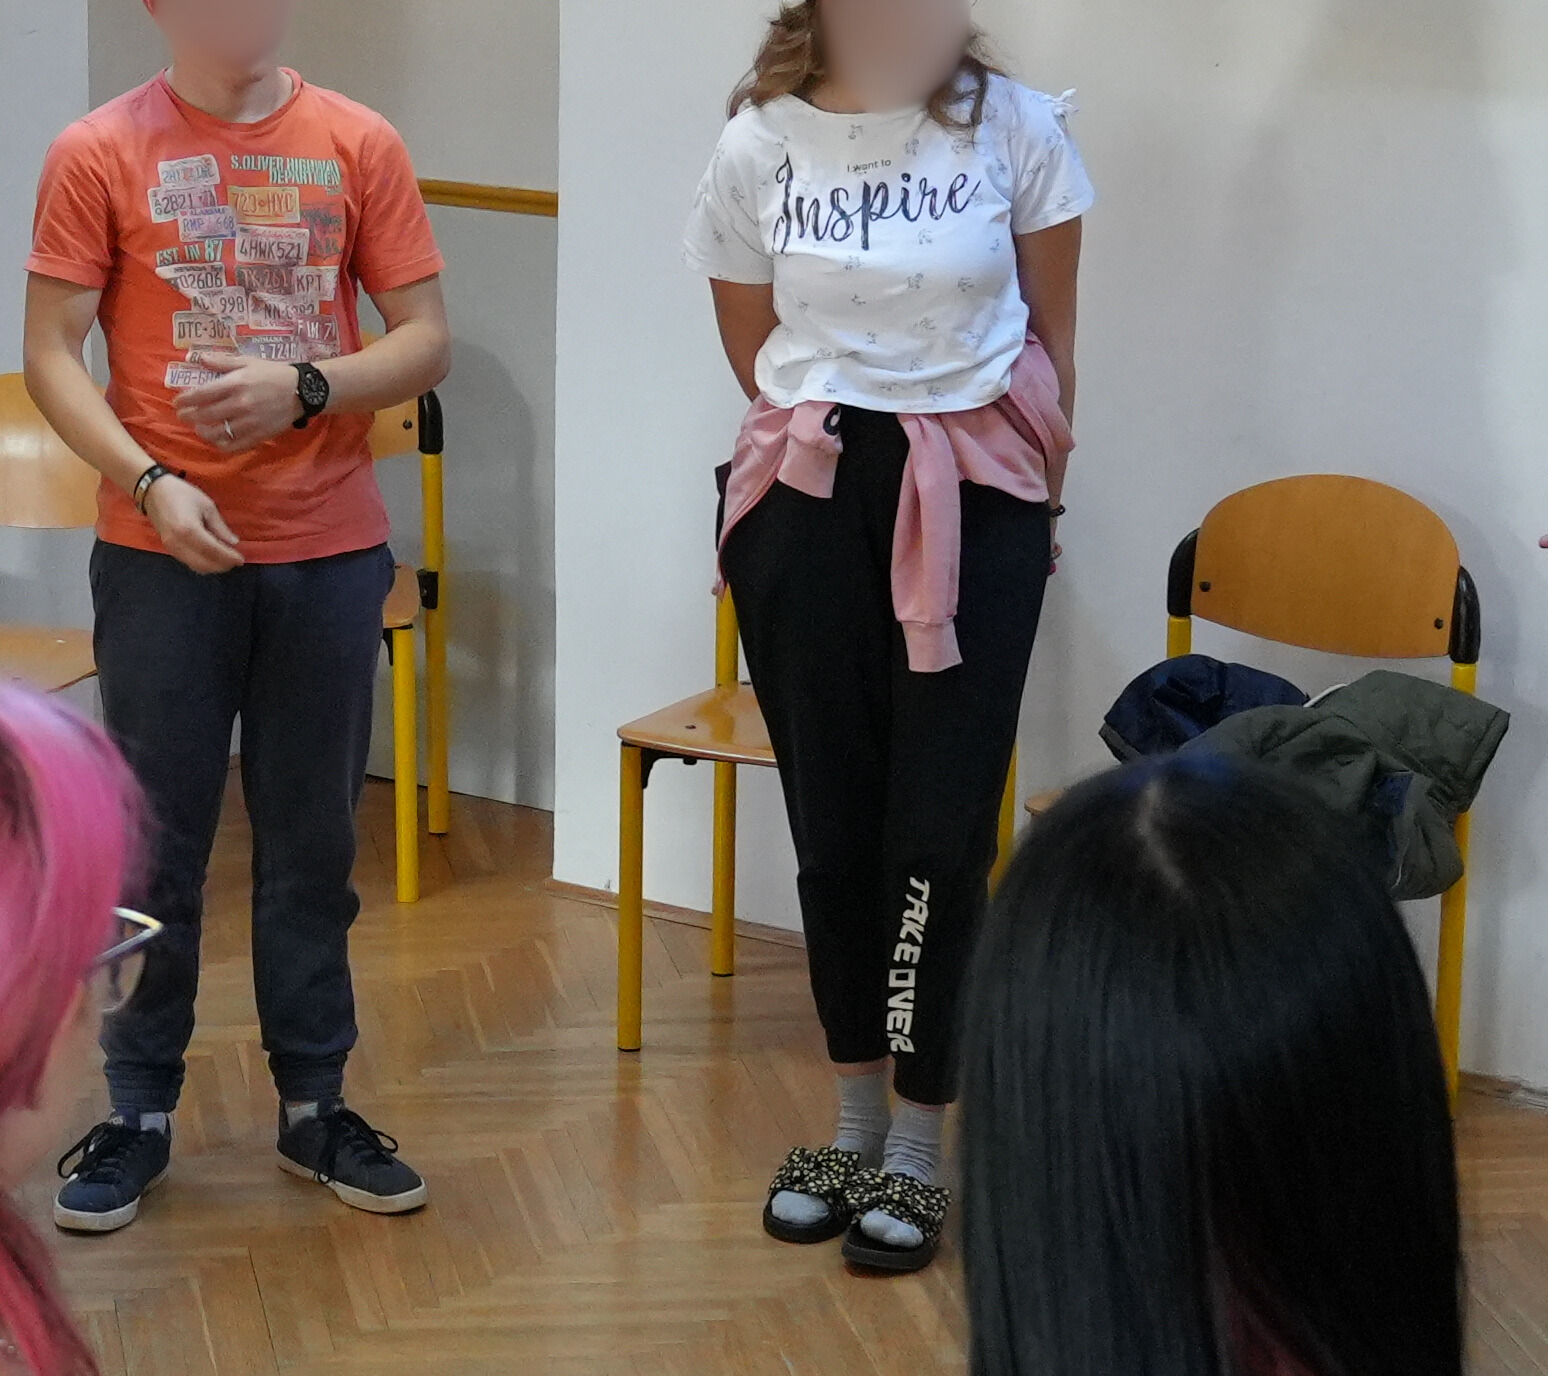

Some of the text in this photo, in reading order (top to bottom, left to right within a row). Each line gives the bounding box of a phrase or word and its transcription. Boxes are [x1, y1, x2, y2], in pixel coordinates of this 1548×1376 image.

[772, 152, 982, 255] Inspire
[893, 876, 930, 964] TAKE
[886, 968, 916, 1054] OVER
